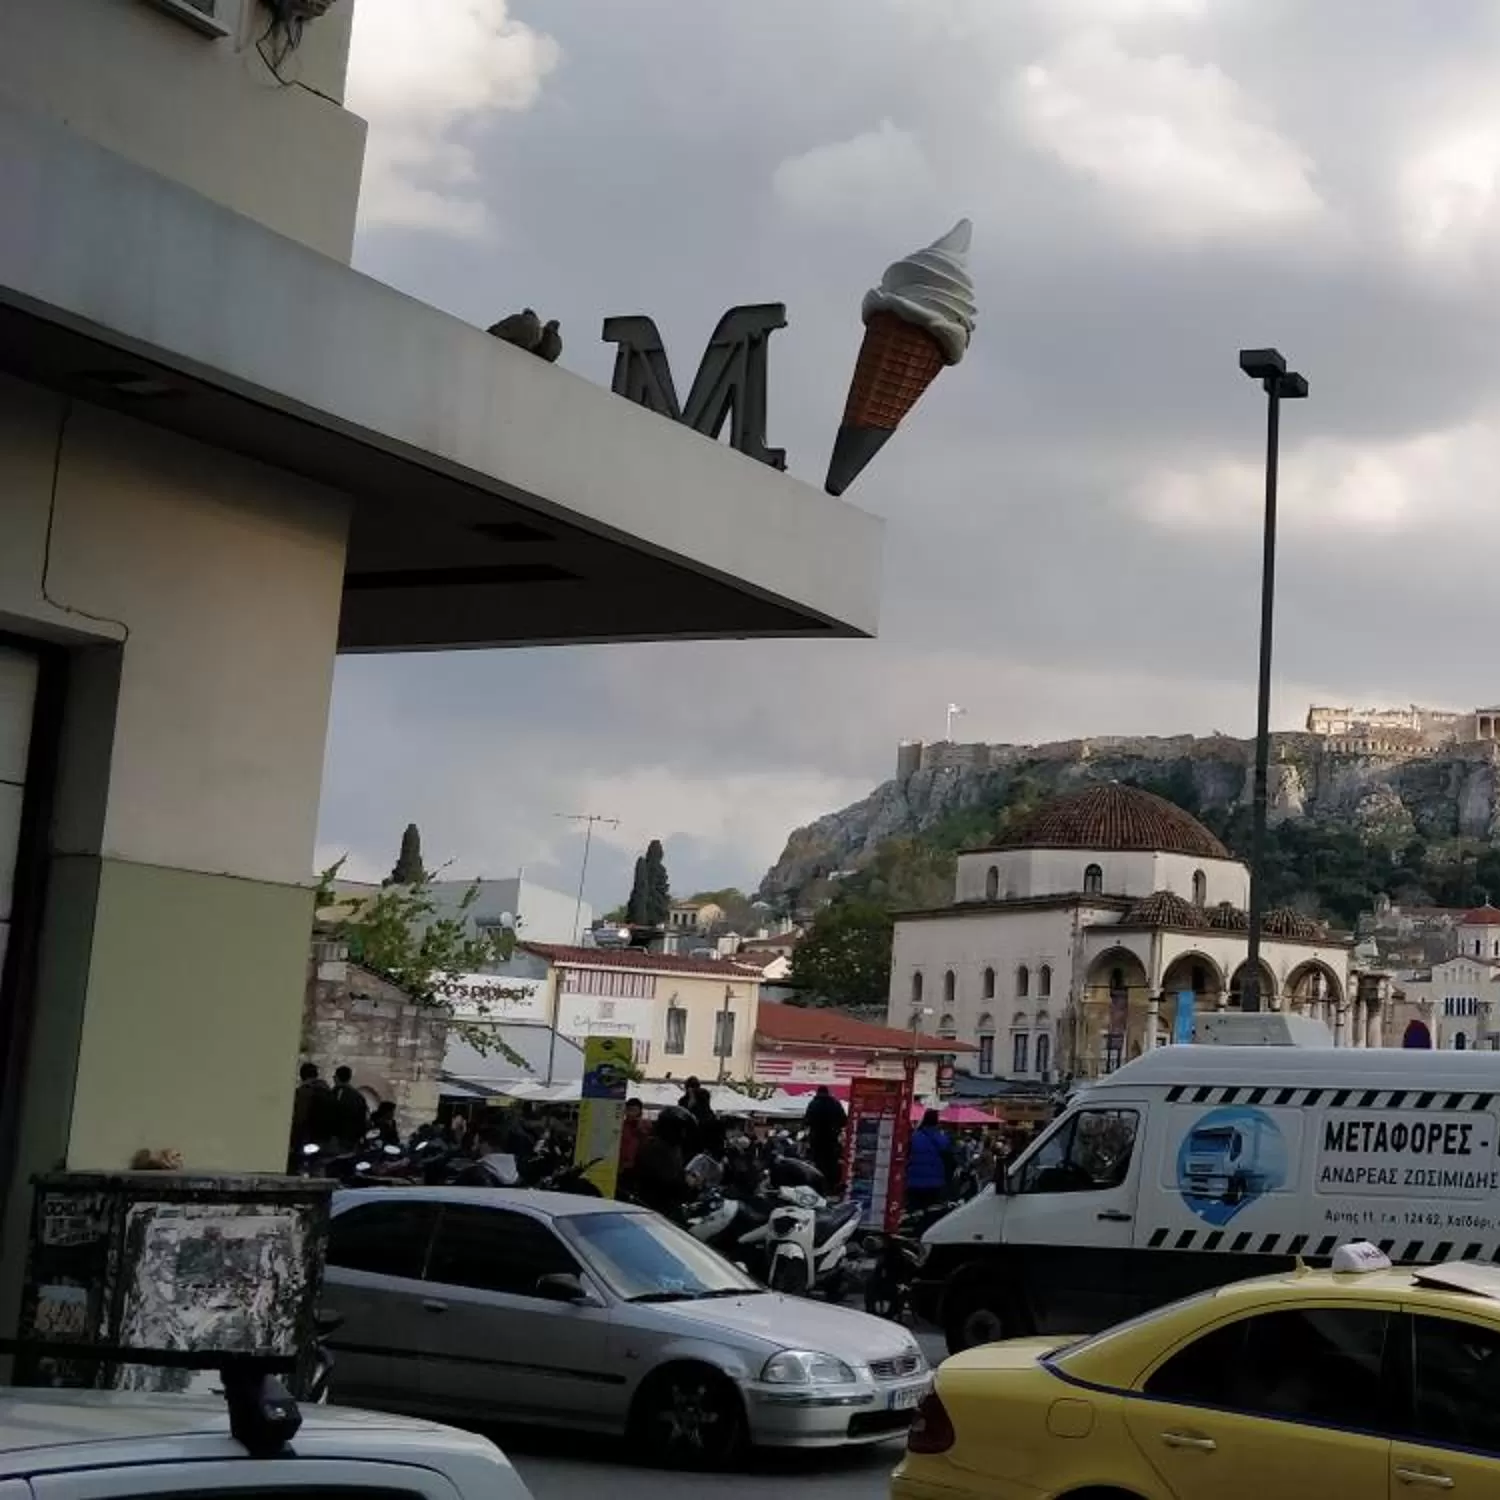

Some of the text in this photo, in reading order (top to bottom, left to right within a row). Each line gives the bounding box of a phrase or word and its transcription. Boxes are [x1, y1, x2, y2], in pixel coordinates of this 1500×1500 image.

[603, 304, 788, 471] M
[1324, 1120, 1473, 1156] ΜΕΤΑΦΟΡΕΣ
[1320, 1165, 1499, 1189] ΑΝΔΡΕΑΣ ΖΩΣΙΜΙΔΗΣ
